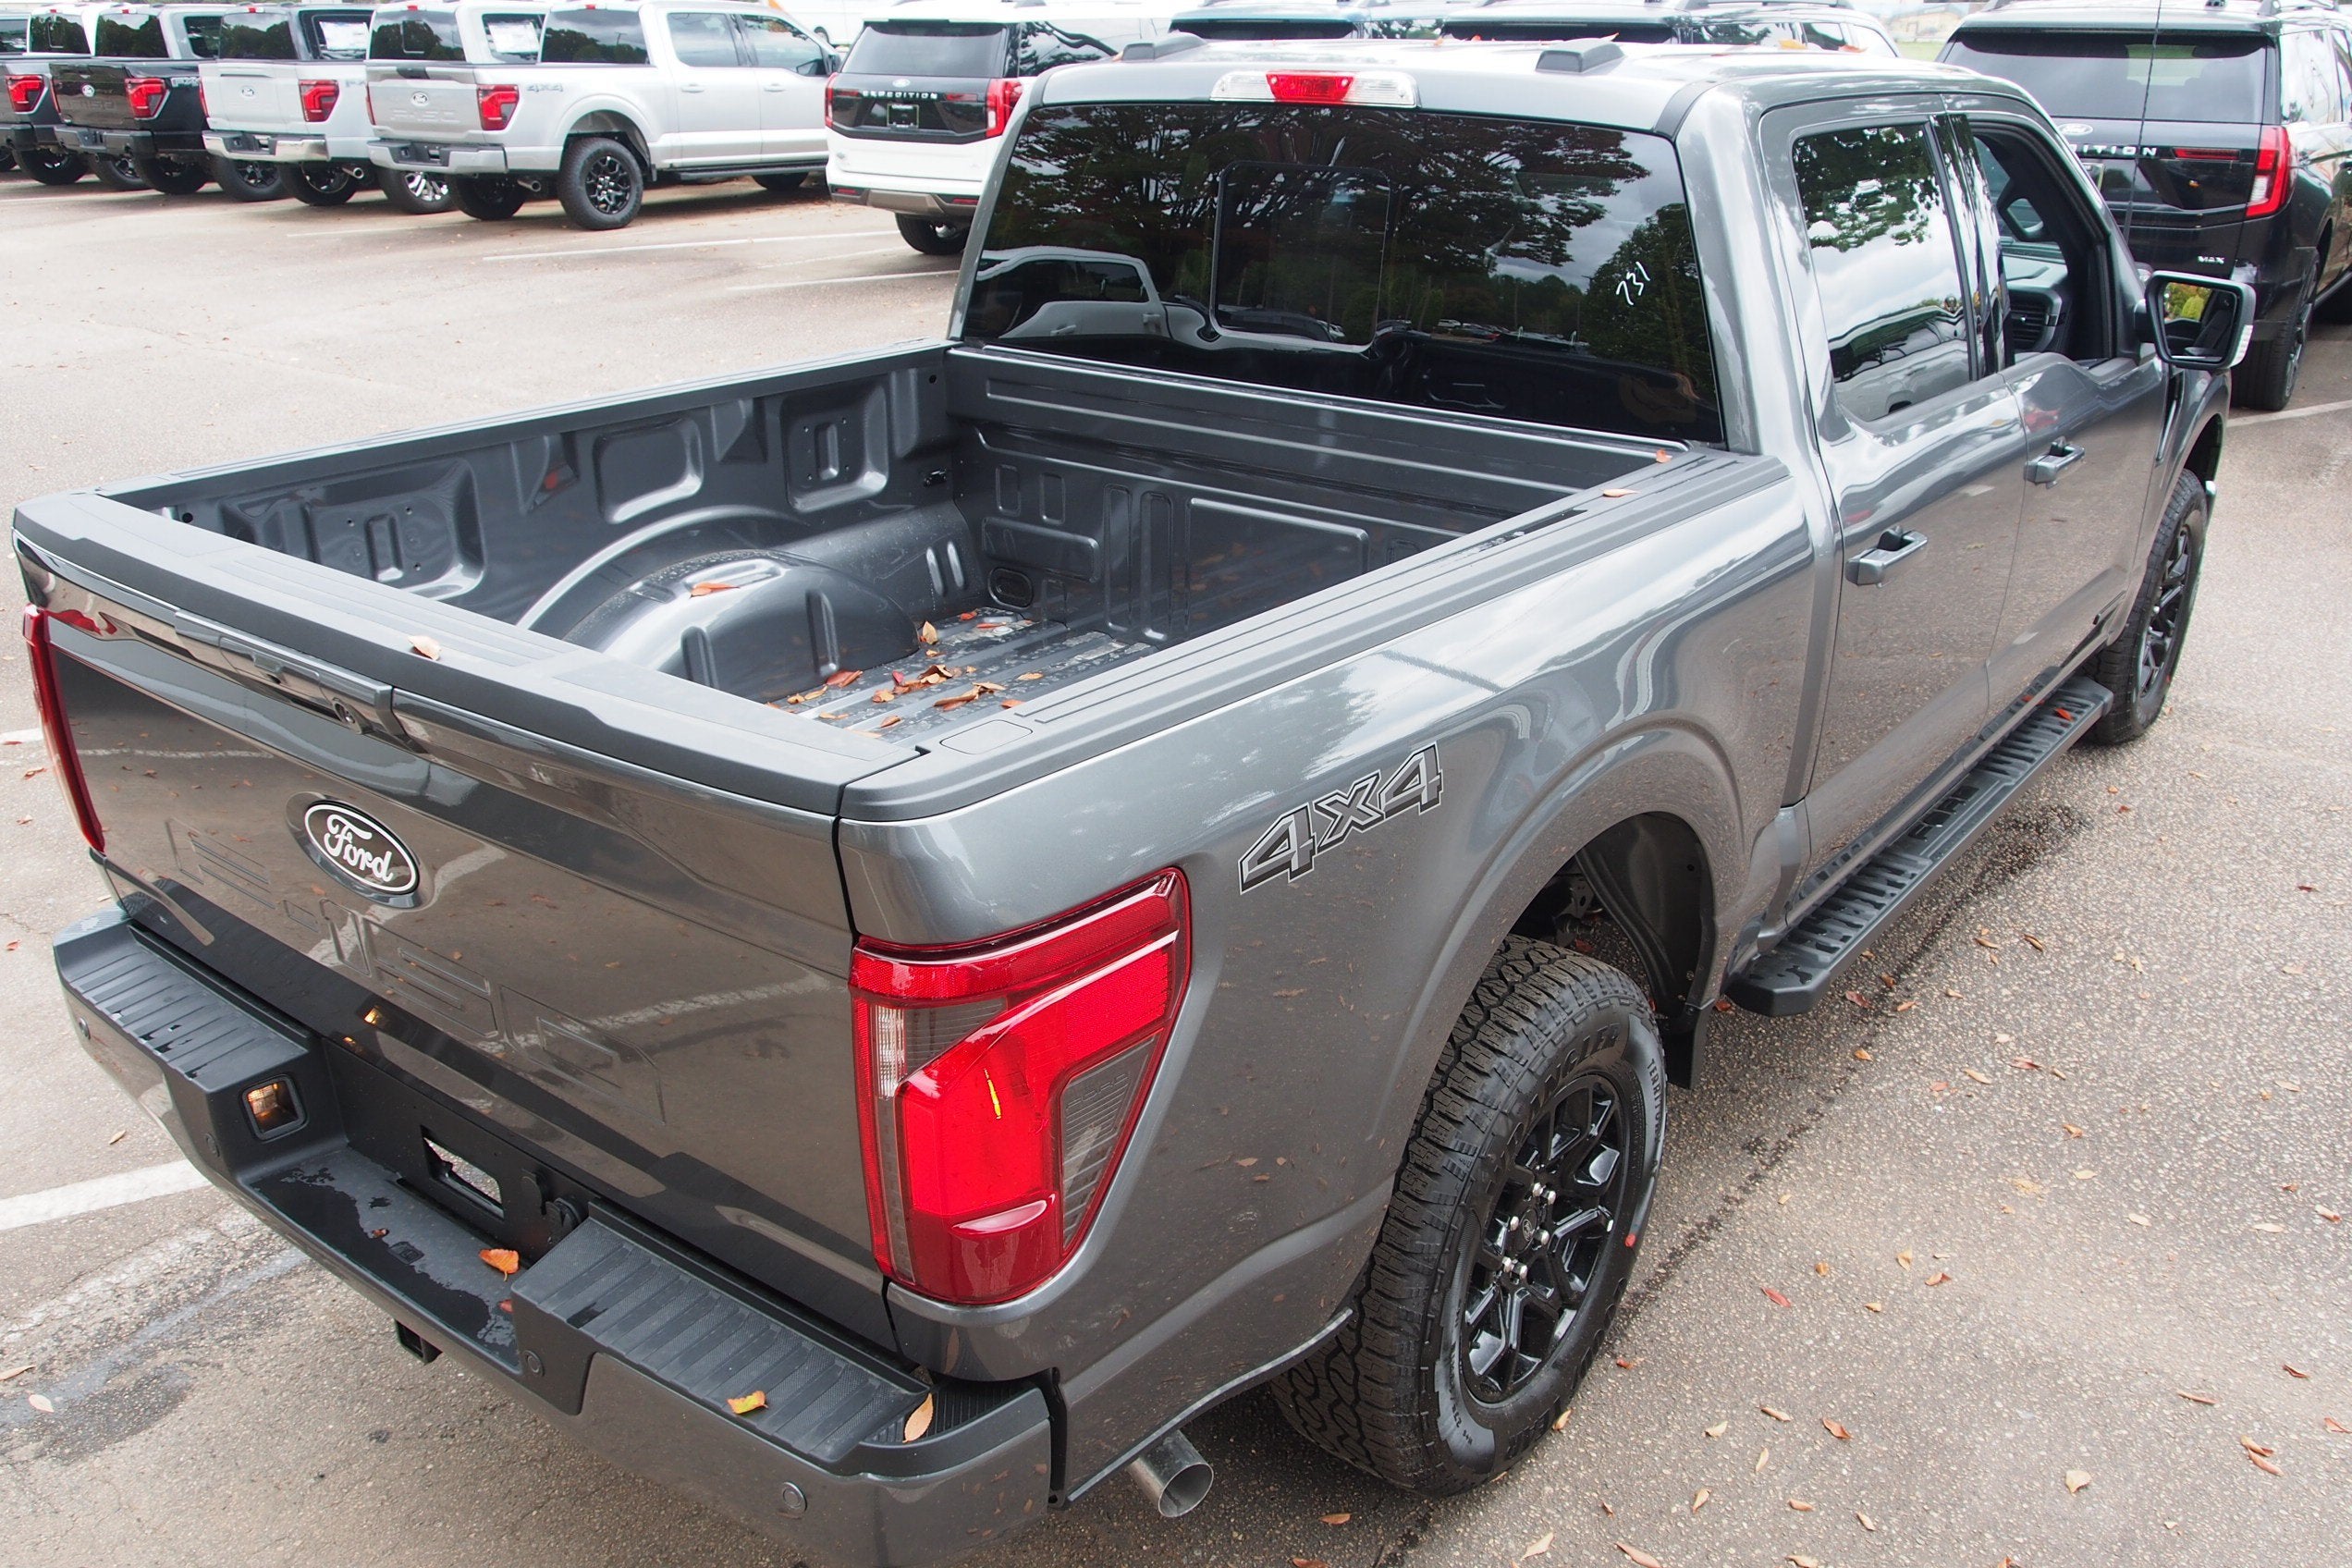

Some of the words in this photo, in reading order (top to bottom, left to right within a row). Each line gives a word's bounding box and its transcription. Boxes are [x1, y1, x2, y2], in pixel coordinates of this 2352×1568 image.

[863, 90, 938, 100] EXPEDITION
[1615, 261, 1651, 306] 731
[2198, 256, 2225, 264] MAX
[1238, 741, 1443, 895] 4X4
[1906, 785, 1980, 842] FORD
[324, 814, 394, 882] Ford
[165, 816, 668, 1127] F-150
